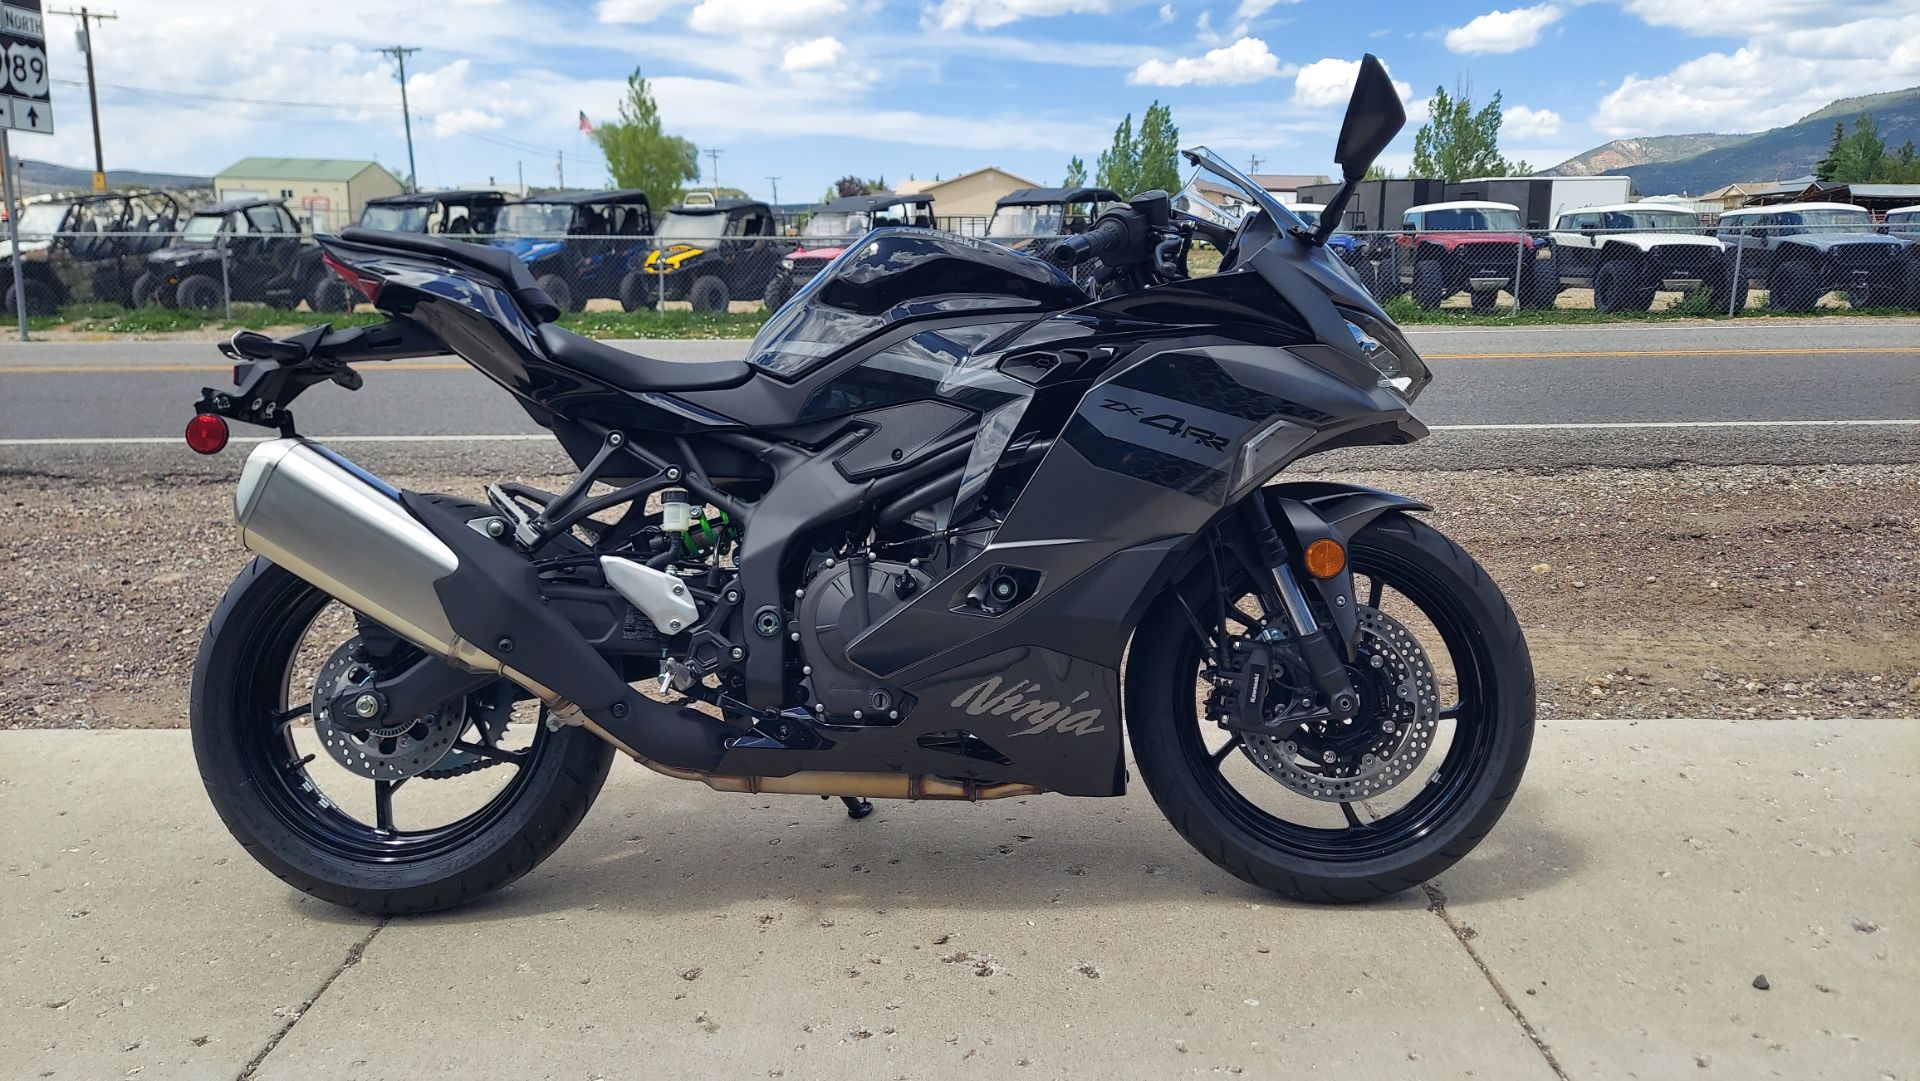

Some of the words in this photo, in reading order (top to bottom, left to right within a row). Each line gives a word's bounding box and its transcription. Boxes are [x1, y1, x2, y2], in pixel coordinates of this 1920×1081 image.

[5, 10, 41, 34] NORTH
[13, 54, 43, 84] 89
[895, 226, 980, 250] Kawasaki
[951, 676, 1105, 738] Ninja
